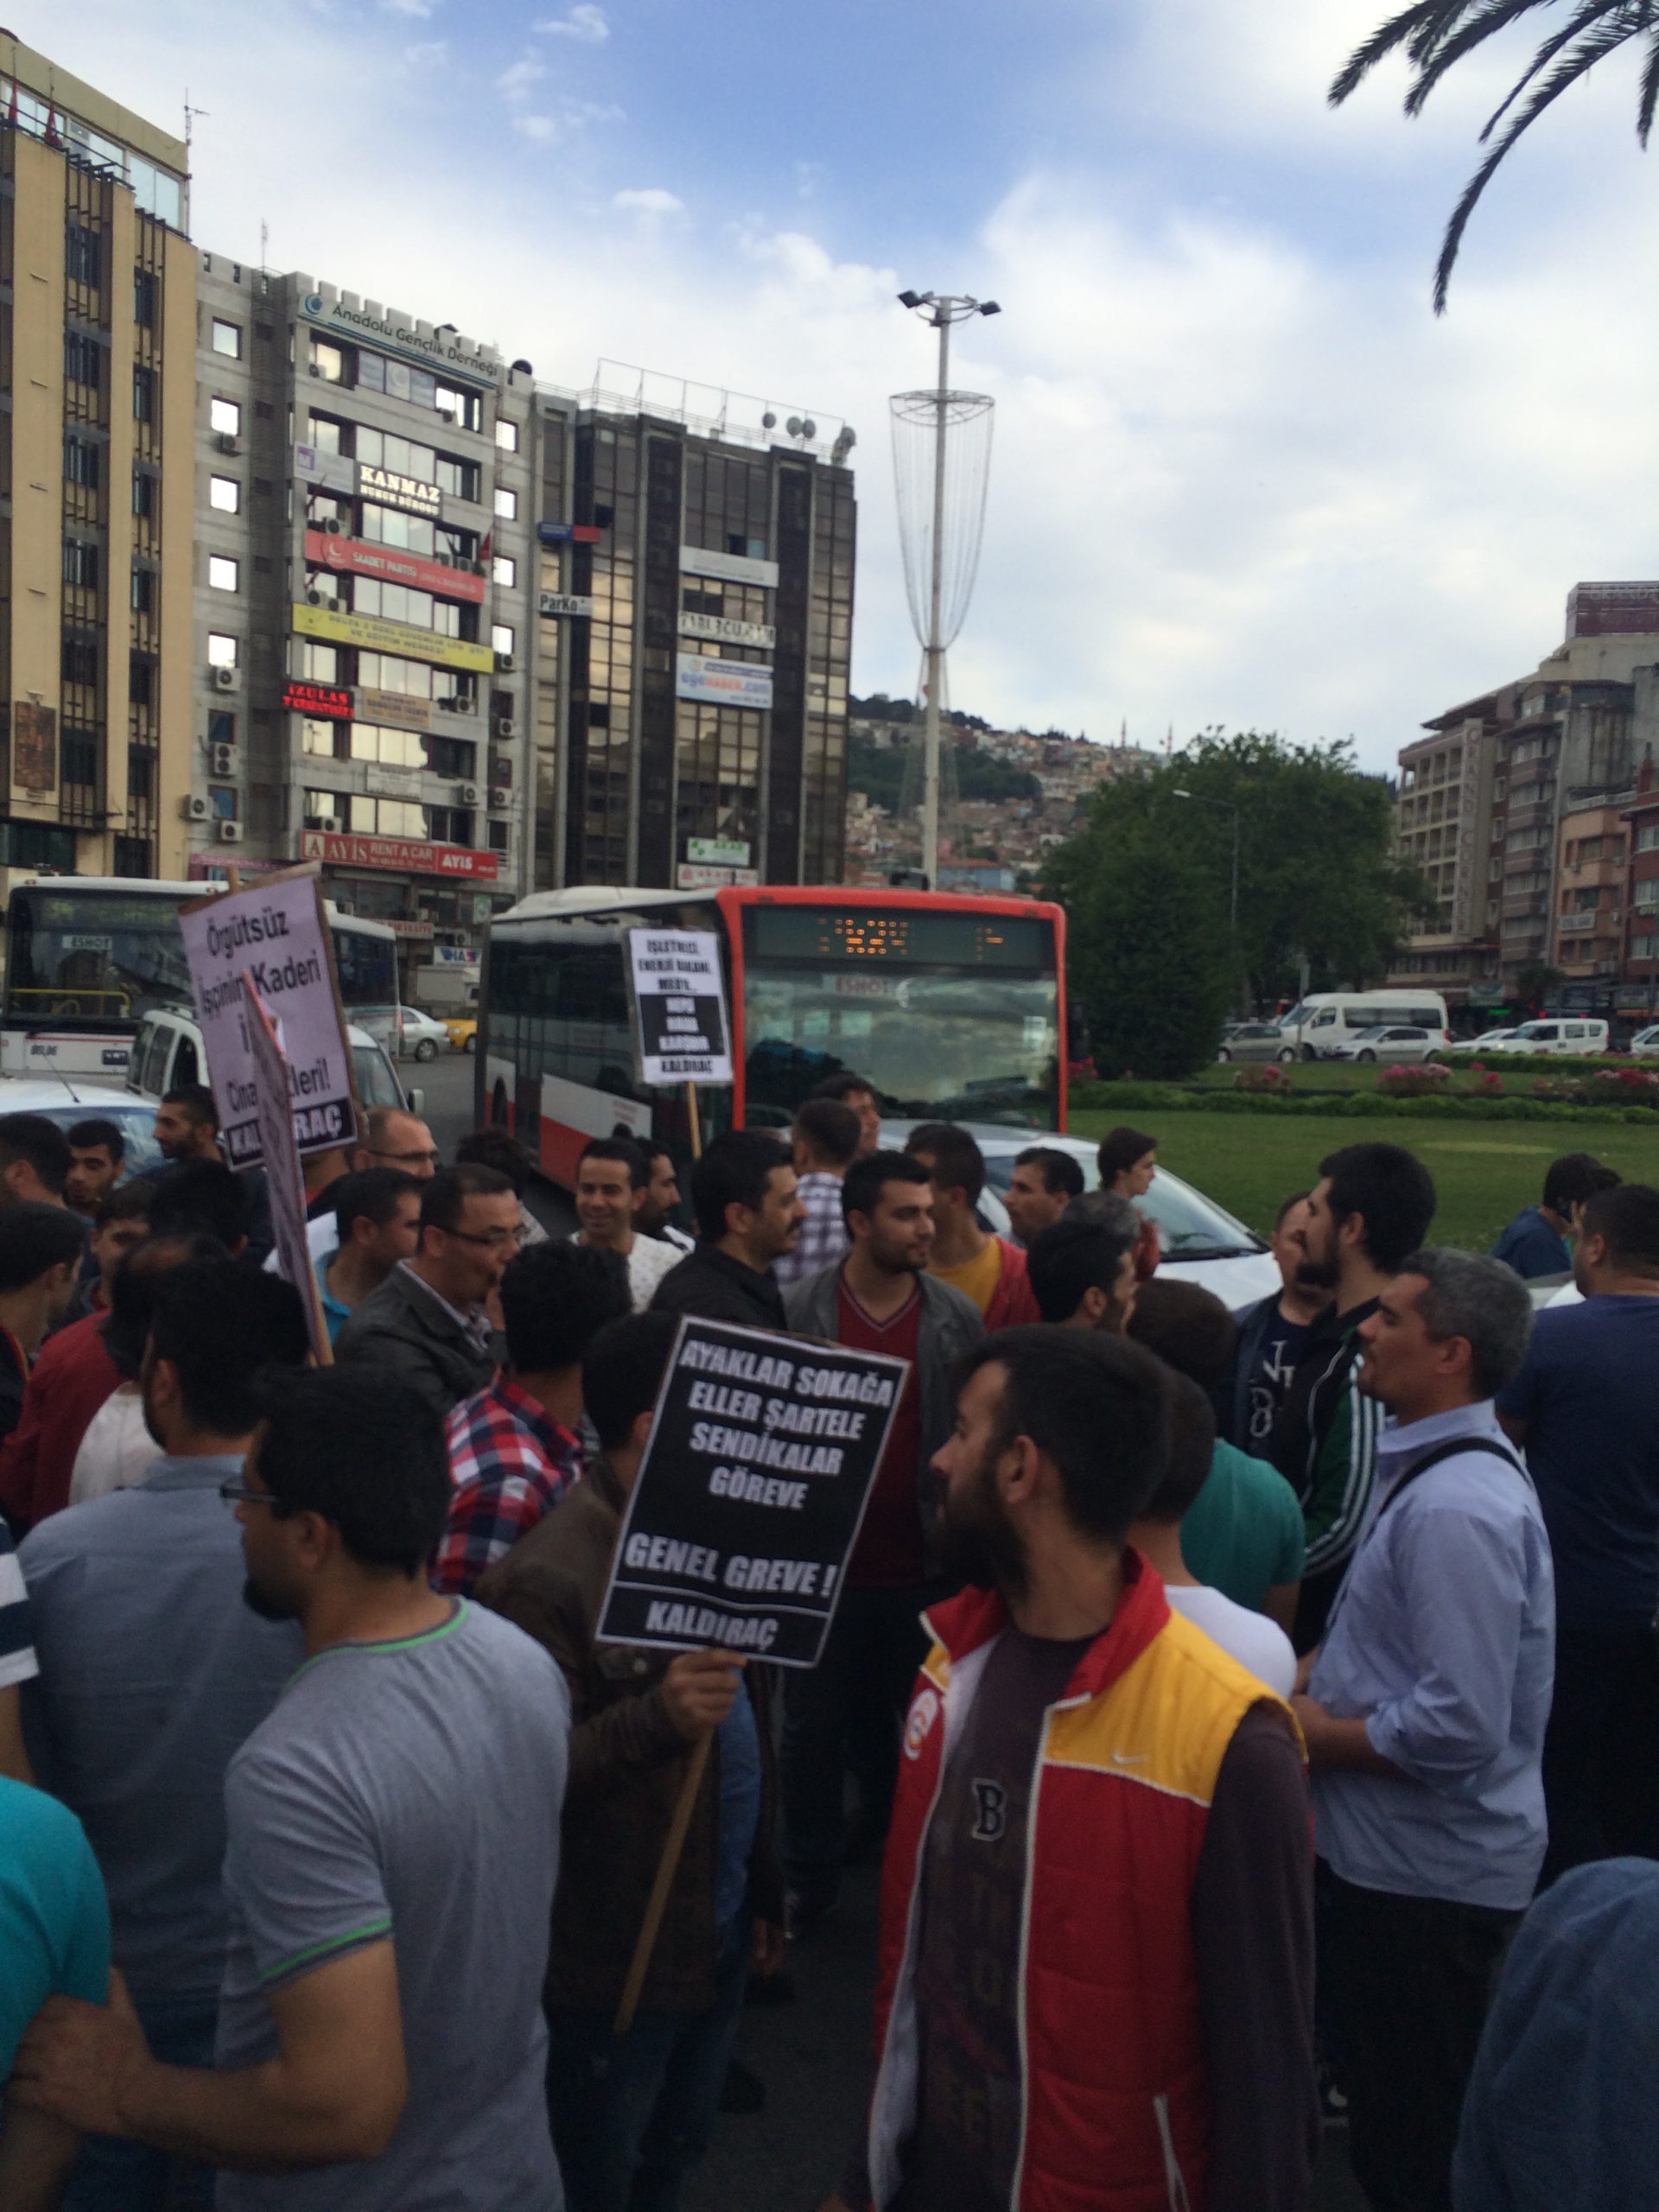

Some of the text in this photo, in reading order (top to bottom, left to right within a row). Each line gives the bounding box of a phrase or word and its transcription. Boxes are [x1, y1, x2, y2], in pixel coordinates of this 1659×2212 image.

[333, 304, 392, 337] Anadolu
[396, 327, 444, 357] Gençlik
[448, 346, 498, 377] Derneği
[359, 465, 441, 504] KANMAZ
[370, 842, 398, 856] RENT
[400, 848, 410, 858] A
[411, 847, 434, 861] CAR
[206, 906, 290, 959] Örgütsüz
[250, 949, 322, 995] Kaderi
[677, 1338, 894, 1408] AYAKLAR SOKAĞA
[688, 1380, 867, 1440] ELLER ŞARTELE
[690, 1421, 845, 1477] SENDİKALAR
[709, 1465, 810, 1510] GÖREVE
[625, 1531, 721, 1583] GENEL
[723, 1554, 819, 1595] GREVE
[645, 1599, 779, 1651] KALDIRAÇ
[971, 1777, 1007, 1841] B
